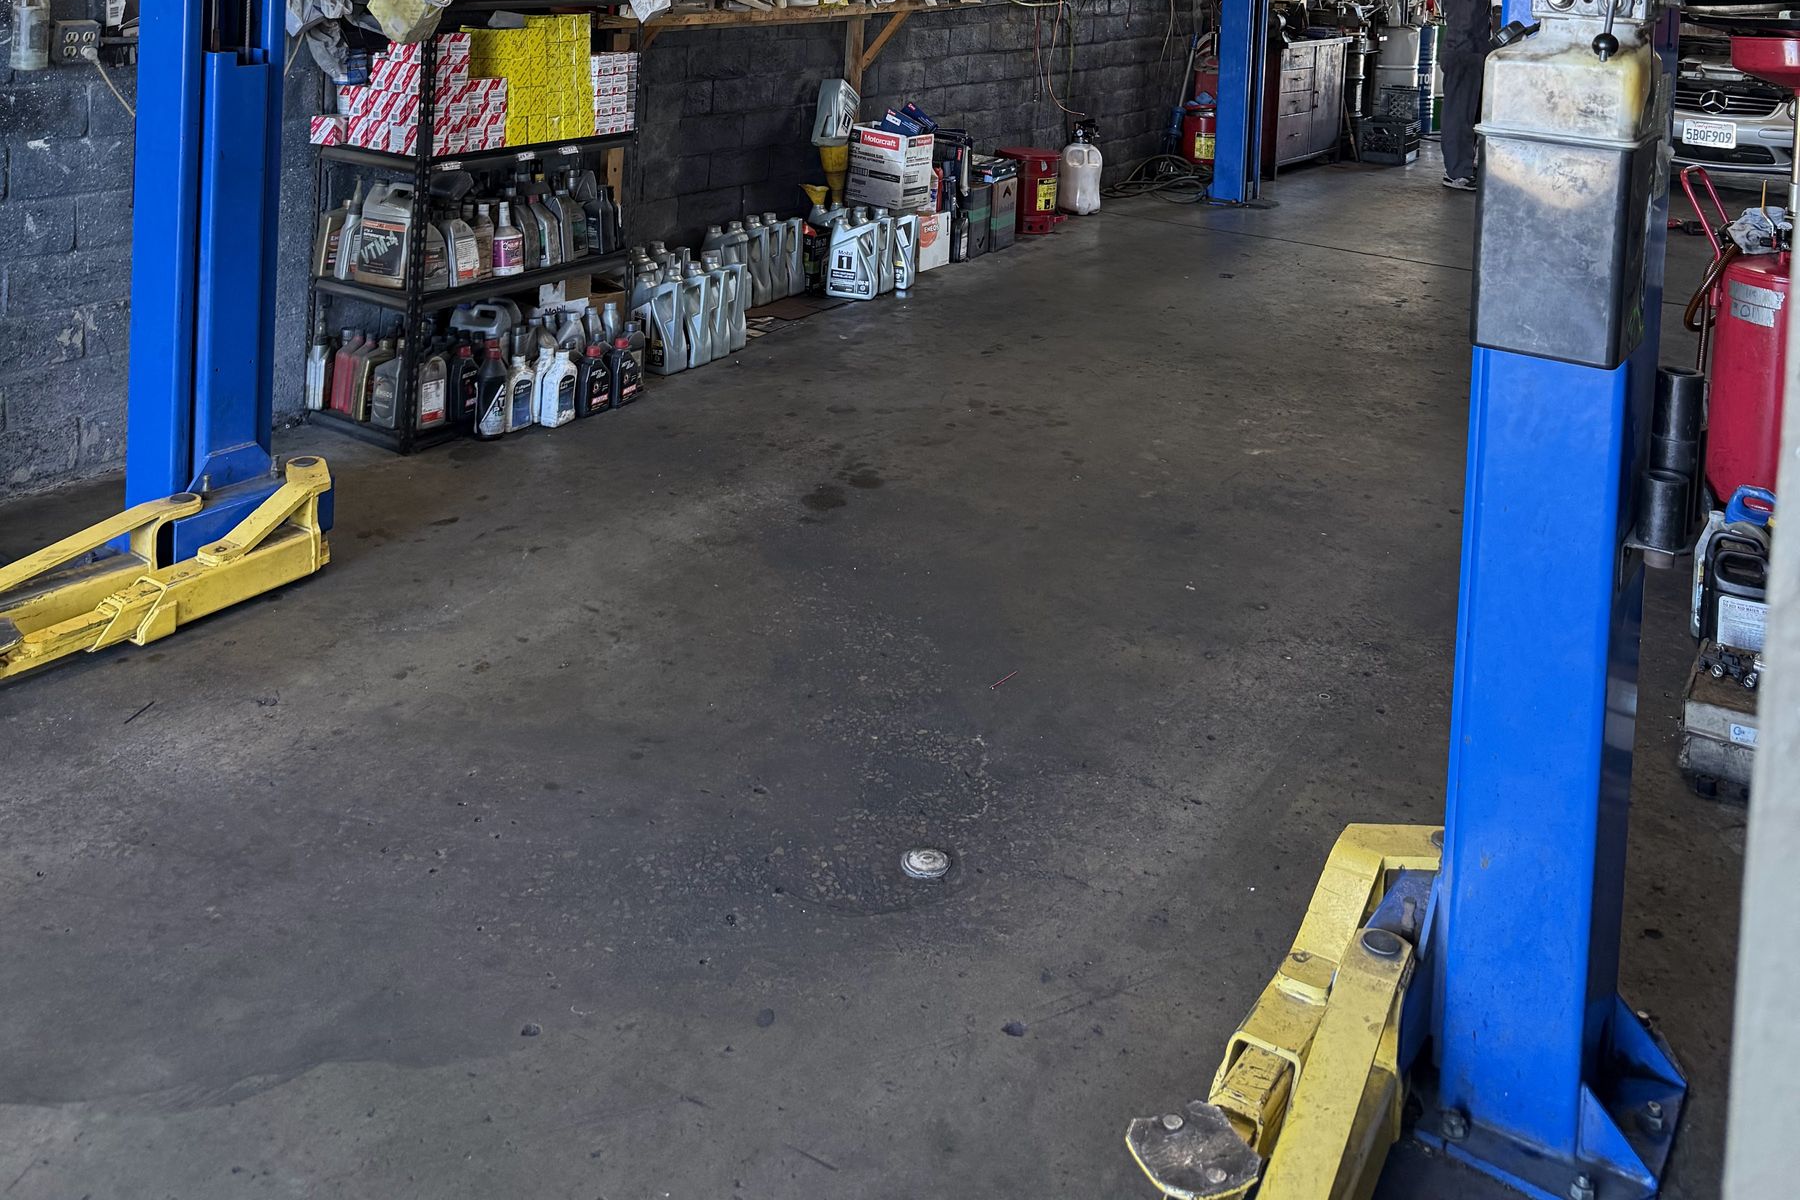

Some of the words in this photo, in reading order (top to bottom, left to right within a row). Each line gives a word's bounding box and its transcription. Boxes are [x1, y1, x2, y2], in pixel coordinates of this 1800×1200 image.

[863, 134, 897, 147] Motorcraft
[1686, 128, 1732, 143] 5BQF909
[924, 224, 940, 233] ENEOS
[360, 230, 399, 264] VTM-4
[841, 256, 849, 268] 1
[544, 305, 566, 315] Mobil
